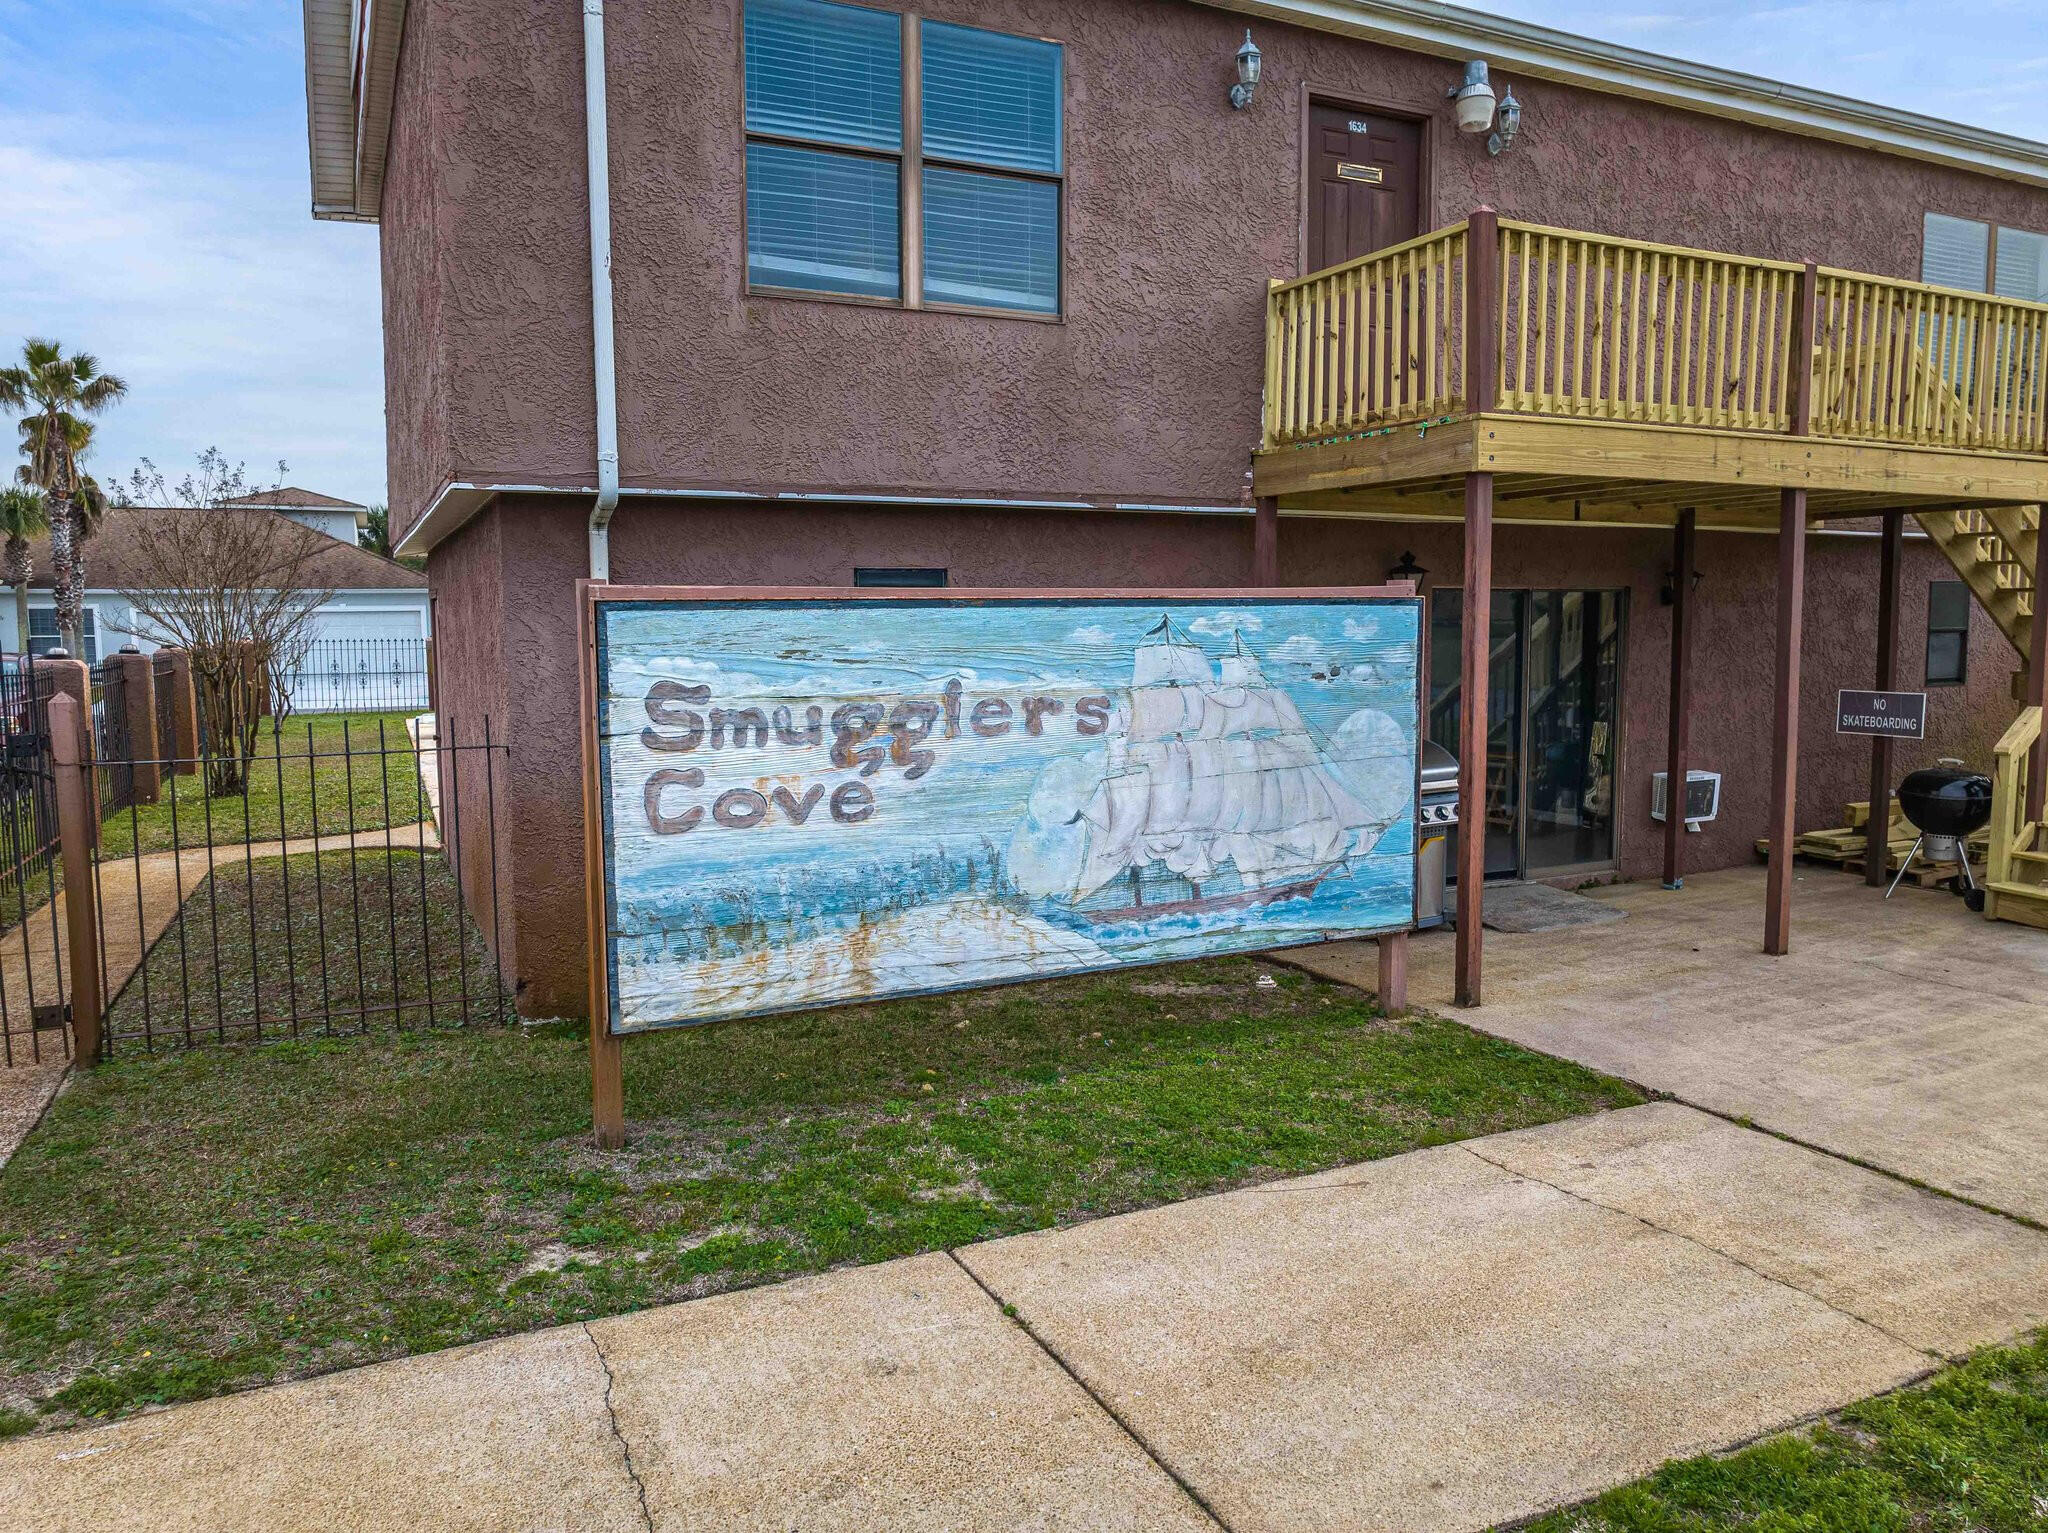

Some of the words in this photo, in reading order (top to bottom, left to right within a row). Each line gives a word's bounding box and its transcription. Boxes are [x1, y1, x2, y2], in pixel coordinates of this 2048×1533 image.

[1348, 120, 1367, 134] 1634
[1873, 698, 1887, 711] NO
[640, 679, 1111, 779] Smugglers
[1842, 714, 1917, 730] SKATEBOARDING
[643, 767, 875, 834] Cove
